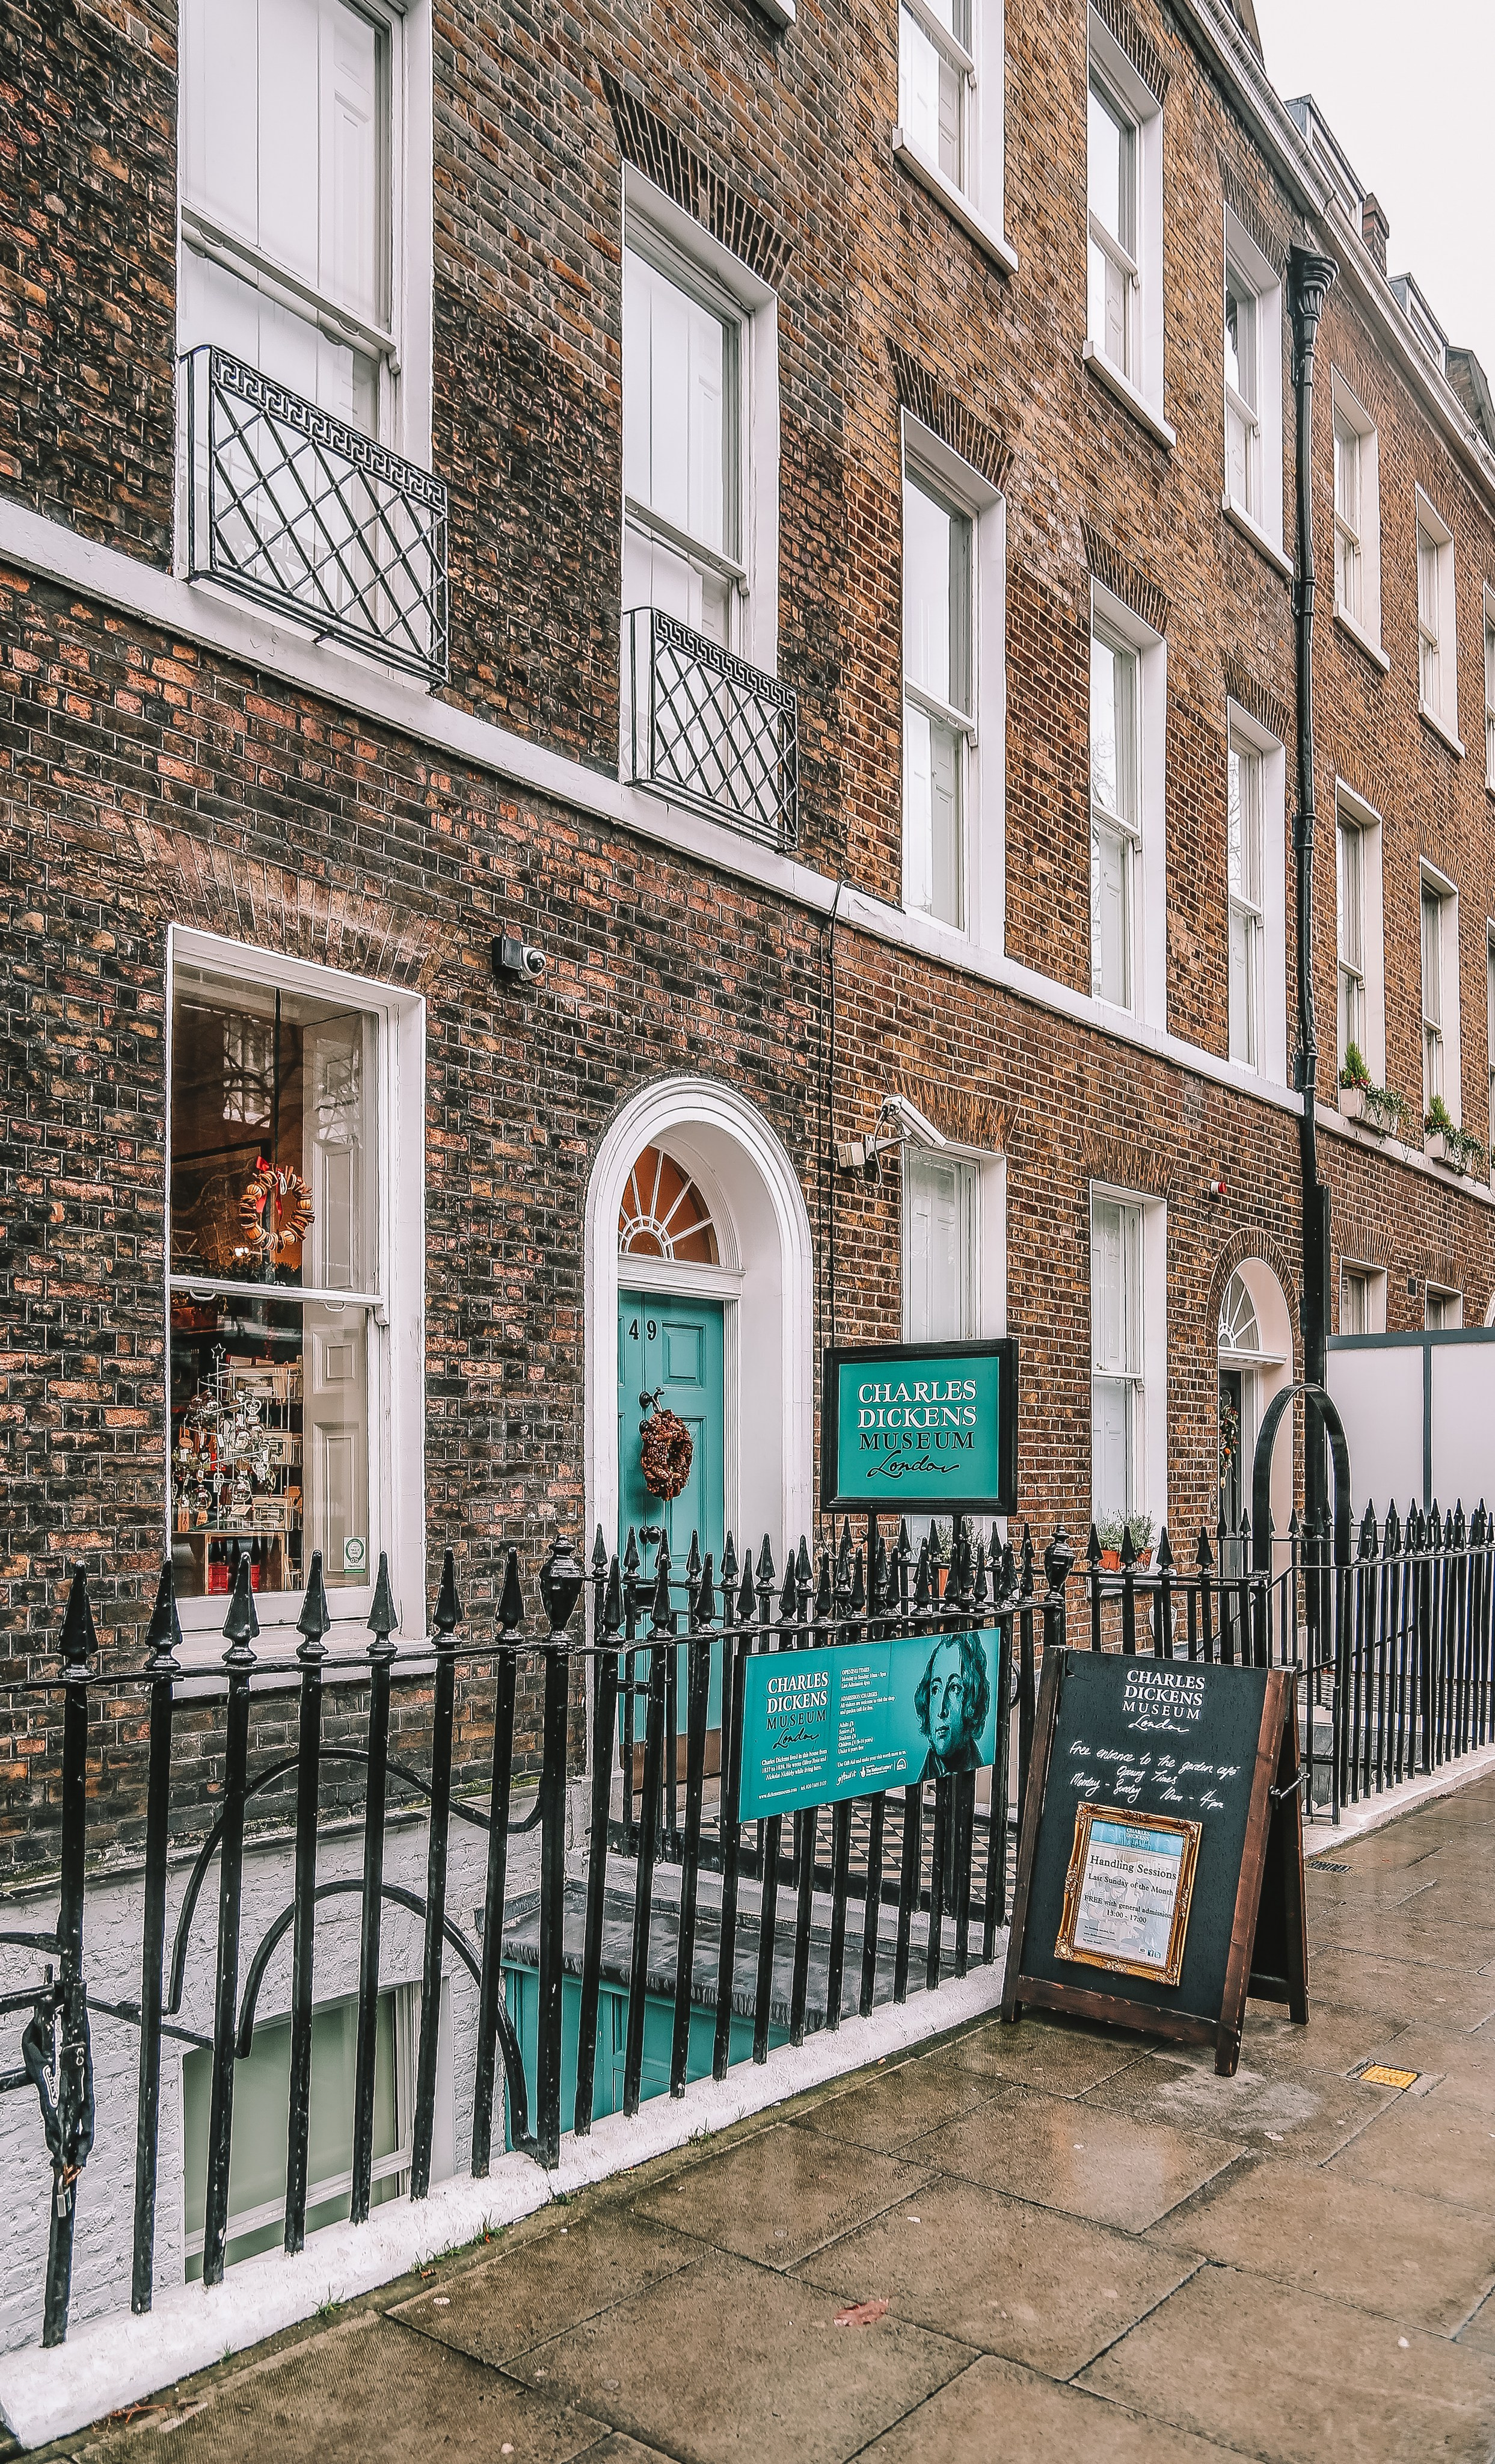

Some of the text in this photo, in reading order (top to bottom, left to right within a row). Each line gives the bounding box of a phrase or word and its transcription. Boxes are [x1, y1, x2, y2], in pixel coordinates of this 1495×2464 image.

[628, 1319, 657, 1341] 49
[858, 1380, 977, 1404] CHARLES
[857, 1406, 977, 1429] DICKENS
[859, 1431, 975, 1450] MUSEUM
[867, 1450, 960, 1479] London
[768, 1672, 828, 1693] CHARLES
[1127, 1669, 1205, 1690] CHARLES
[767, 1690, 827, 1714] DICKENS
[1124, 1684, 1203, 1706] DICKENS
[767, 1710, 826, 1730] MUSEUM
[1122, 1701, 1200, 1720] MUSEUM
[1128, 1714, 1190, 1733] London
[773, 1727, 819, 1749] London
[1069, 1740, 1091, 1755] Free
[1096, 1749, 1135, 1761] entrance
[1140, 1752, 1151, 1764] to
[1178, 1761, 1214, 1774] garden
[1117, 1766, 1177, 1784] Opening Times
[1070, 1772, 1101, 1797] Monday
[1113, 1779, 1141, 1803] Sunday
[1159, 1787, 1183, 1802] 10am
[1126, 1828, 1151, 1837] CHARLES
[1126, 1832, 1150, 1841] DICKENS
[1090, 1855, 1177, 1880] Handling Sessions
[1088, 1873, 1102, 1882] Last
[1104, 1876, 1128, 1887] Sunday
[1138, 1883, 1149, 1891] the
[1150, 1886, 1174, 1896] Month
[1084, 1895, 1173, 1919] FREE with general admission
[1107, 1909, 1123, 1919] 13:00
[1129, 1914, 1147, 1924] 17:00
